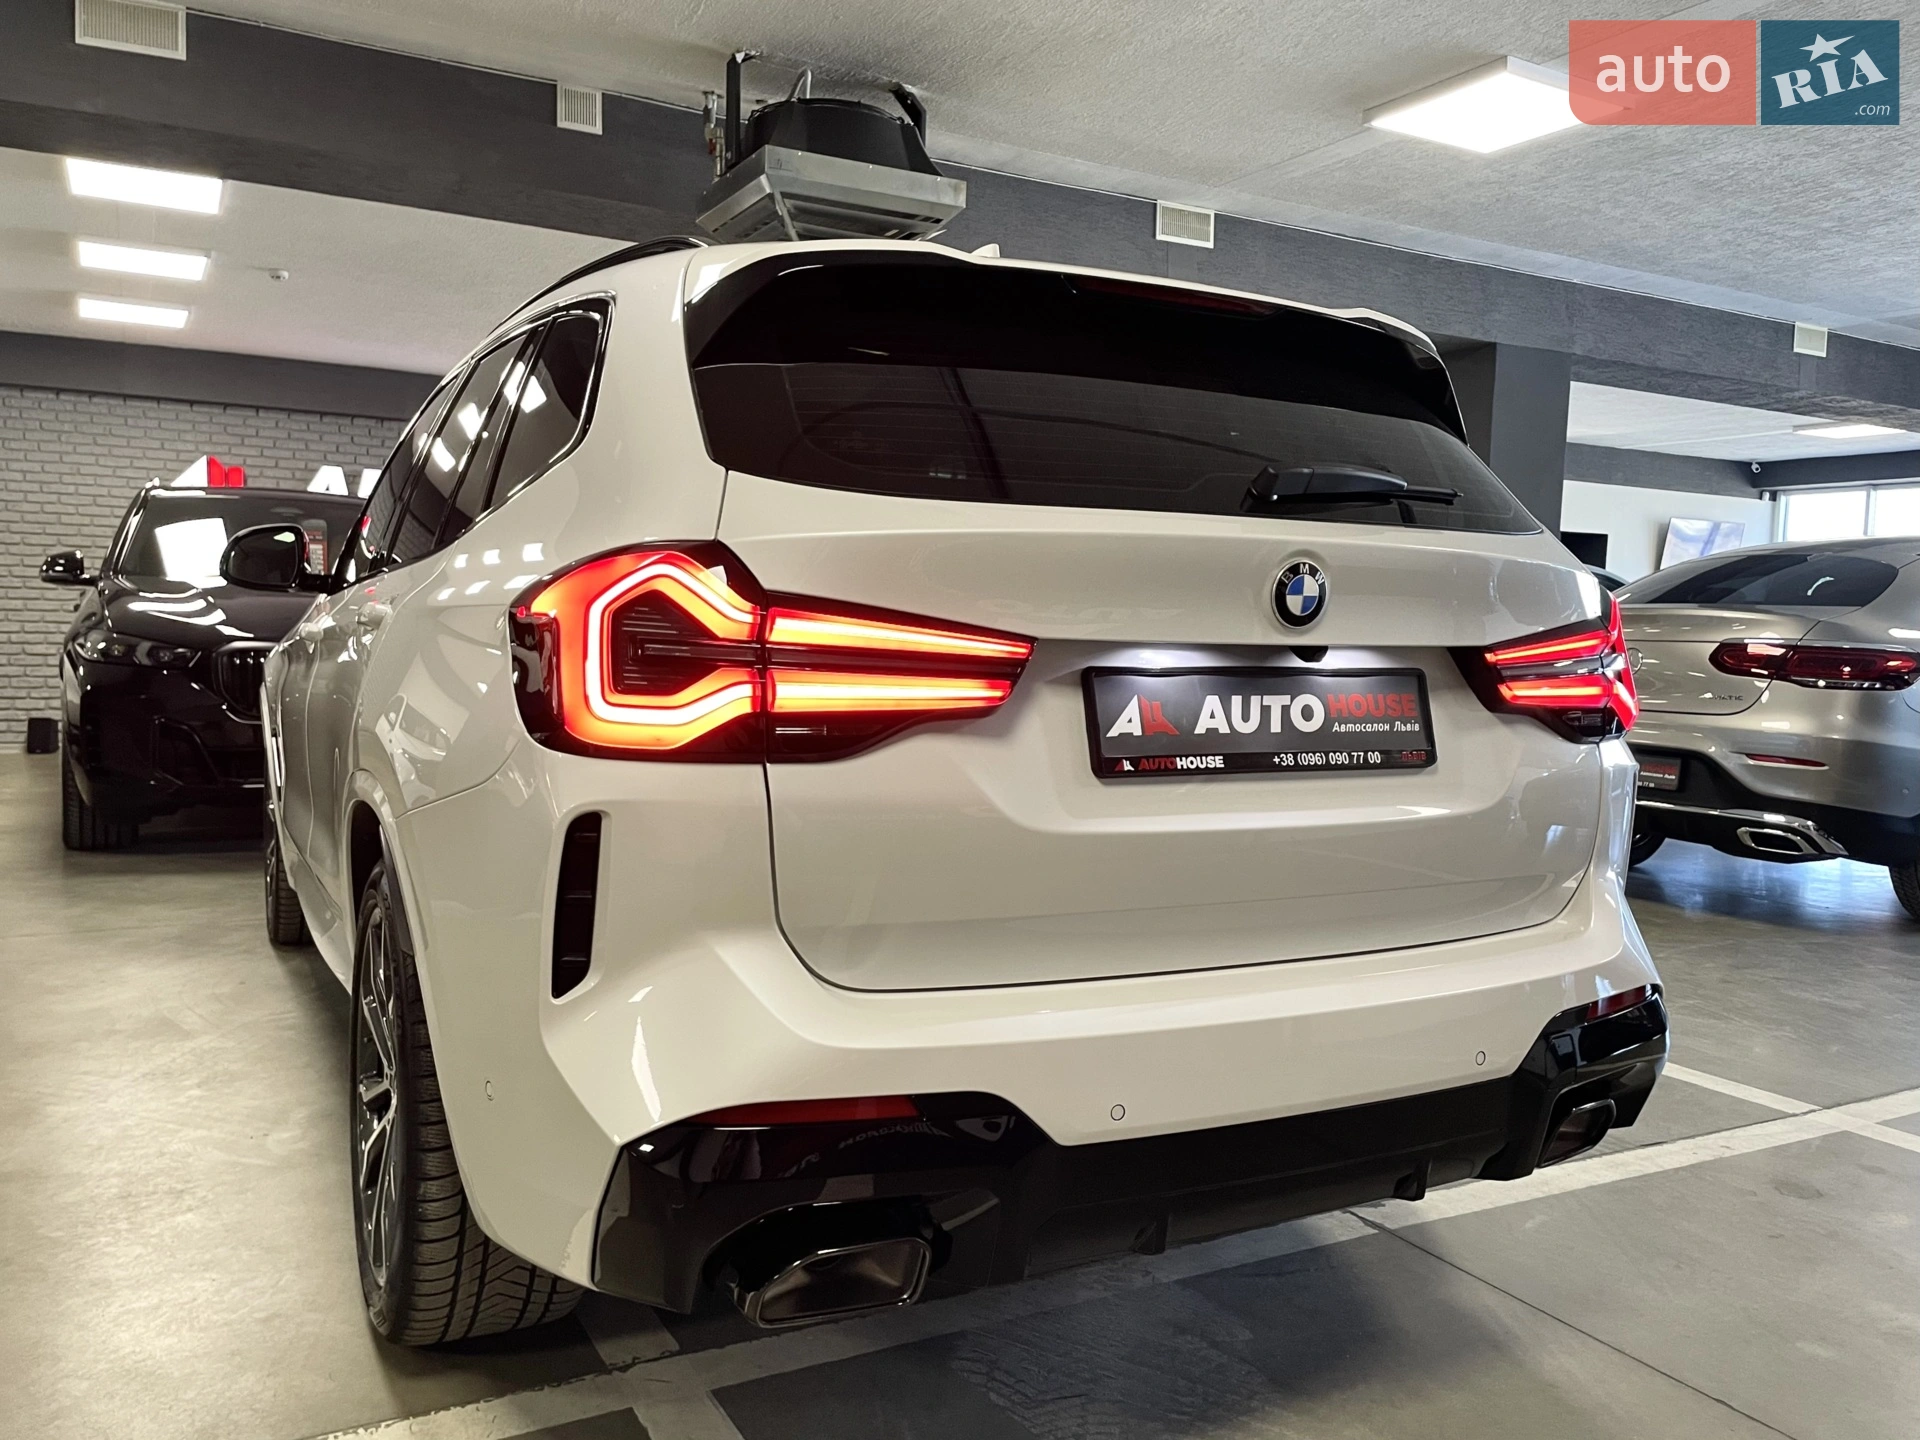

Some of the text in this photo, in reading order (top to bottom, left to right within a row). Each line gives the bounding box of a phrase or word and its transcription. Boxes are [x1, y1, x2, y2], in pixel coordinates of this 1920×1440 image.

[1194, 693, 1418, 735] AUTO HOUSE
[1332, 719, 1420, 733] Автосалон Львів
[1272, 750, 1381, 766] +38 (096) 090 77 00
